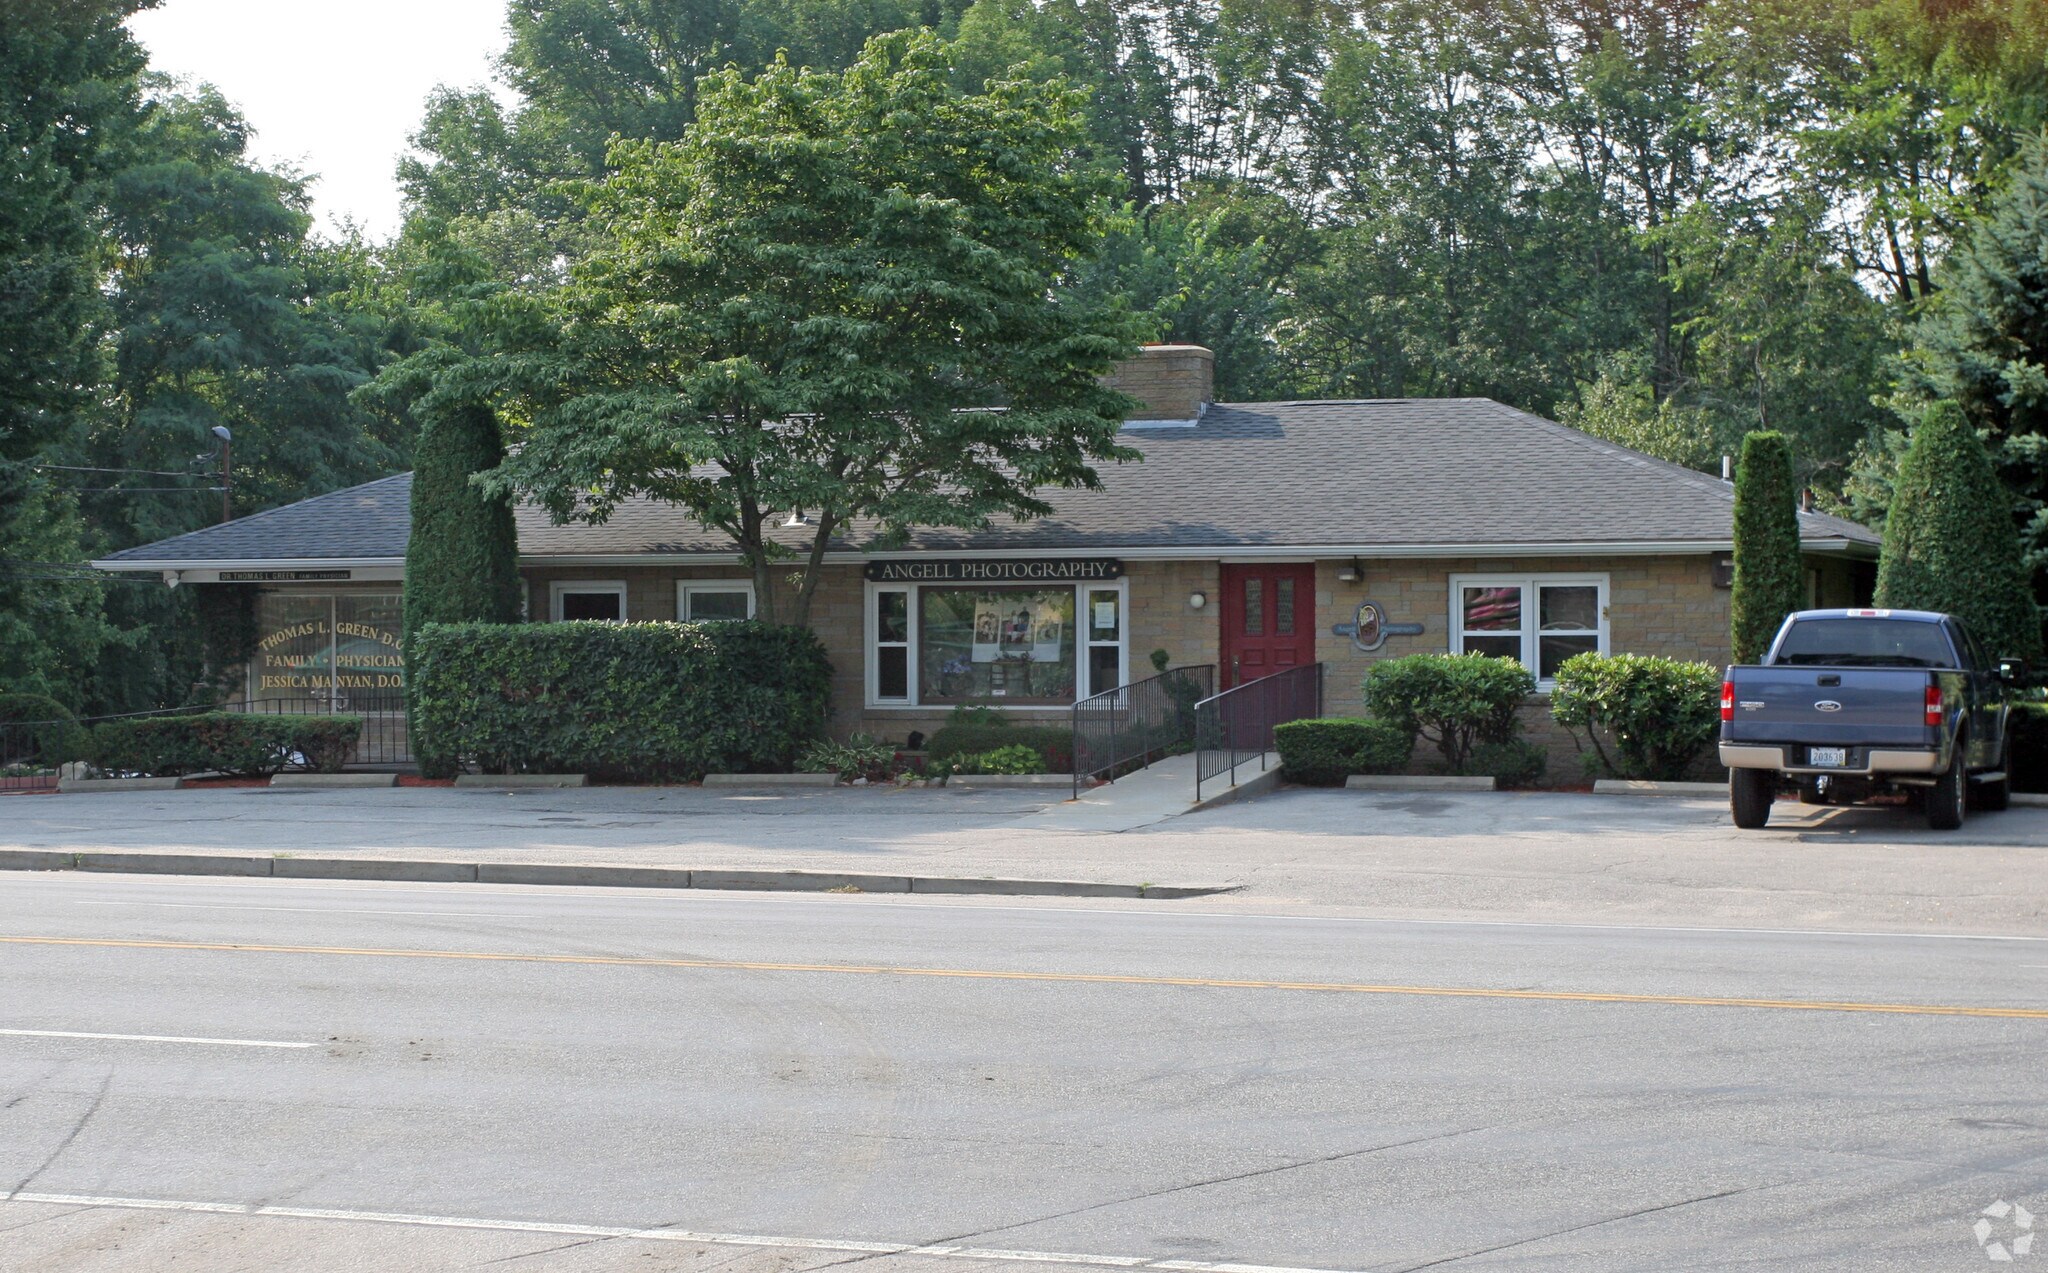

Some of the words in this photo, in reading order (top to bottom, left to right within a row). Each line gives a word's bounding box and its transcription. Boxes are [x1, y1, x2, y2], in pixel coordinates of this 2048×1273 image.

[233, 572, 263, 580] THOMAS
[272, 571, 295, 579] GREEN
[881, 563, 954, 579] ANGELL
[960, 562, 1108, 578] PHOTOGRAPHY
[258, 622, 314, 651] THOMAS
[318, 622, 331, 633] L.
[336, 622, 379, 639] GREEN
[266, 655, 317, 667] FAMILY
[336, 655, 406, 667] PHYSICIAN
[260, 675, 308, 690] JESSICA
